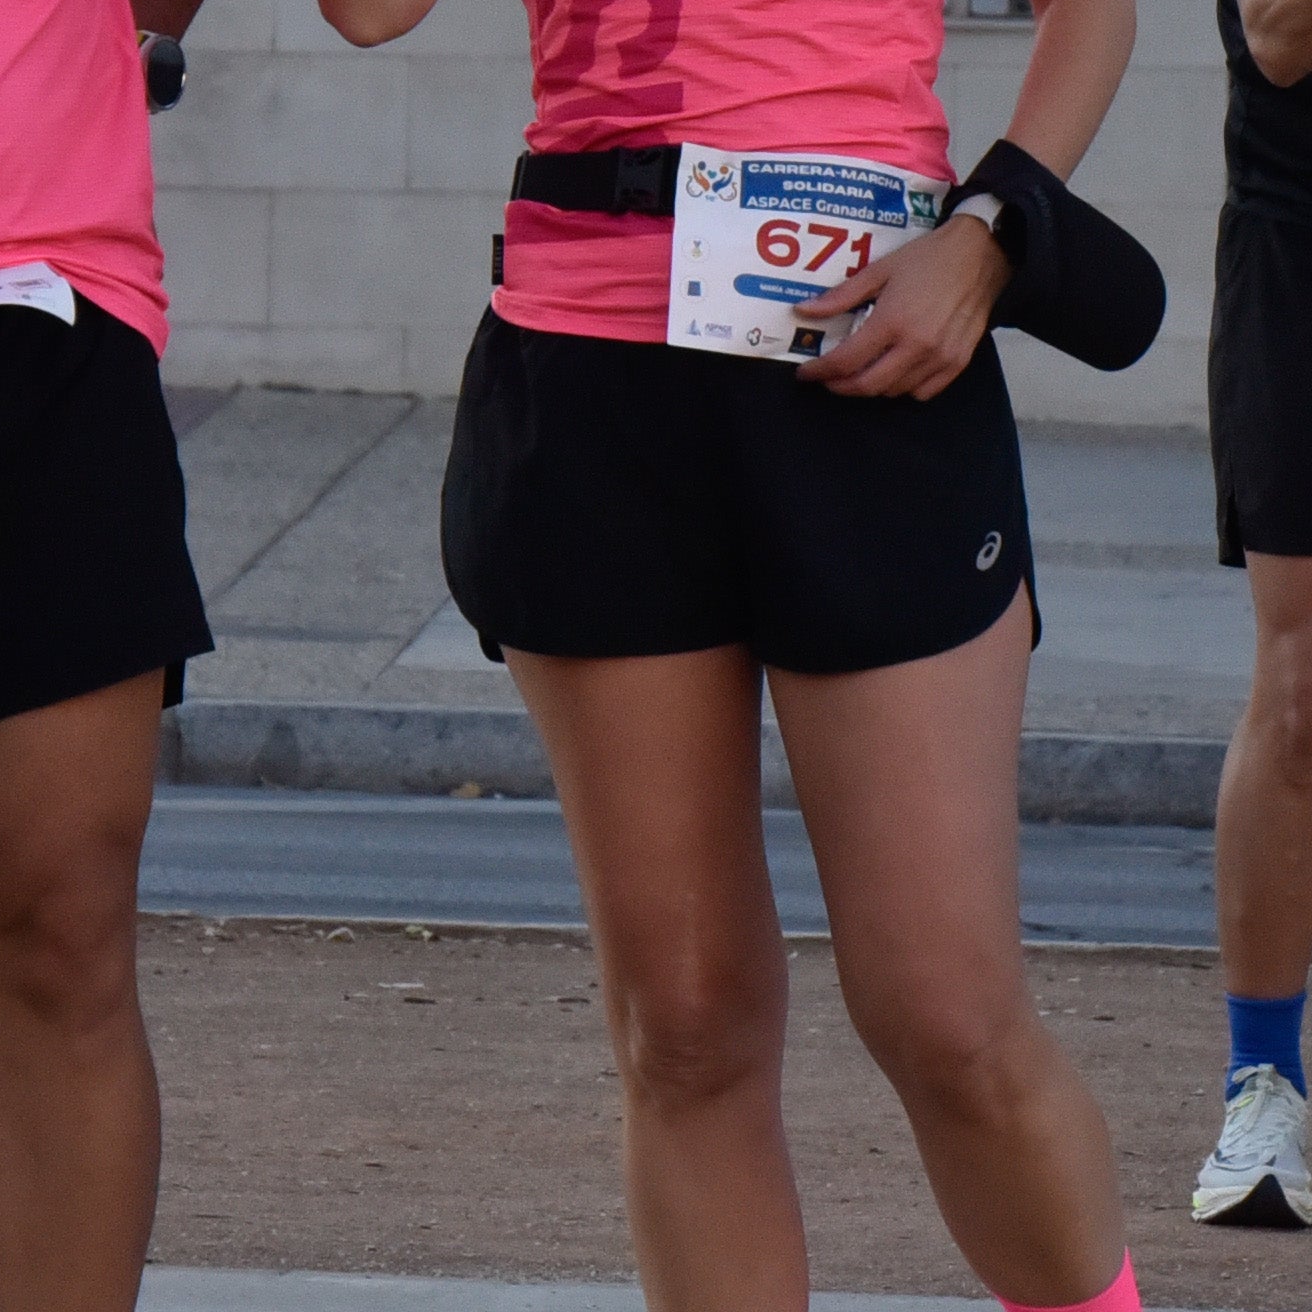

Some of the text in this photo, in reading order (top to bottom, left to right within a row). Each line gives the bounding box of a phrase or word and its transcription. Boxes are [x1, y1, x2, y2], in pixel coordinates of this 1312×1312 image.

[748, 163, 902, 191] CARRERA-MARCHA
[783, 181, 875, 200] SOLIDARIA
[746, 195, 812, 210] ASPACE
[816, 199, 875, 220] Granada
[877, 210, 905, 225] 2025
[756, 219, 873, 278] 671
